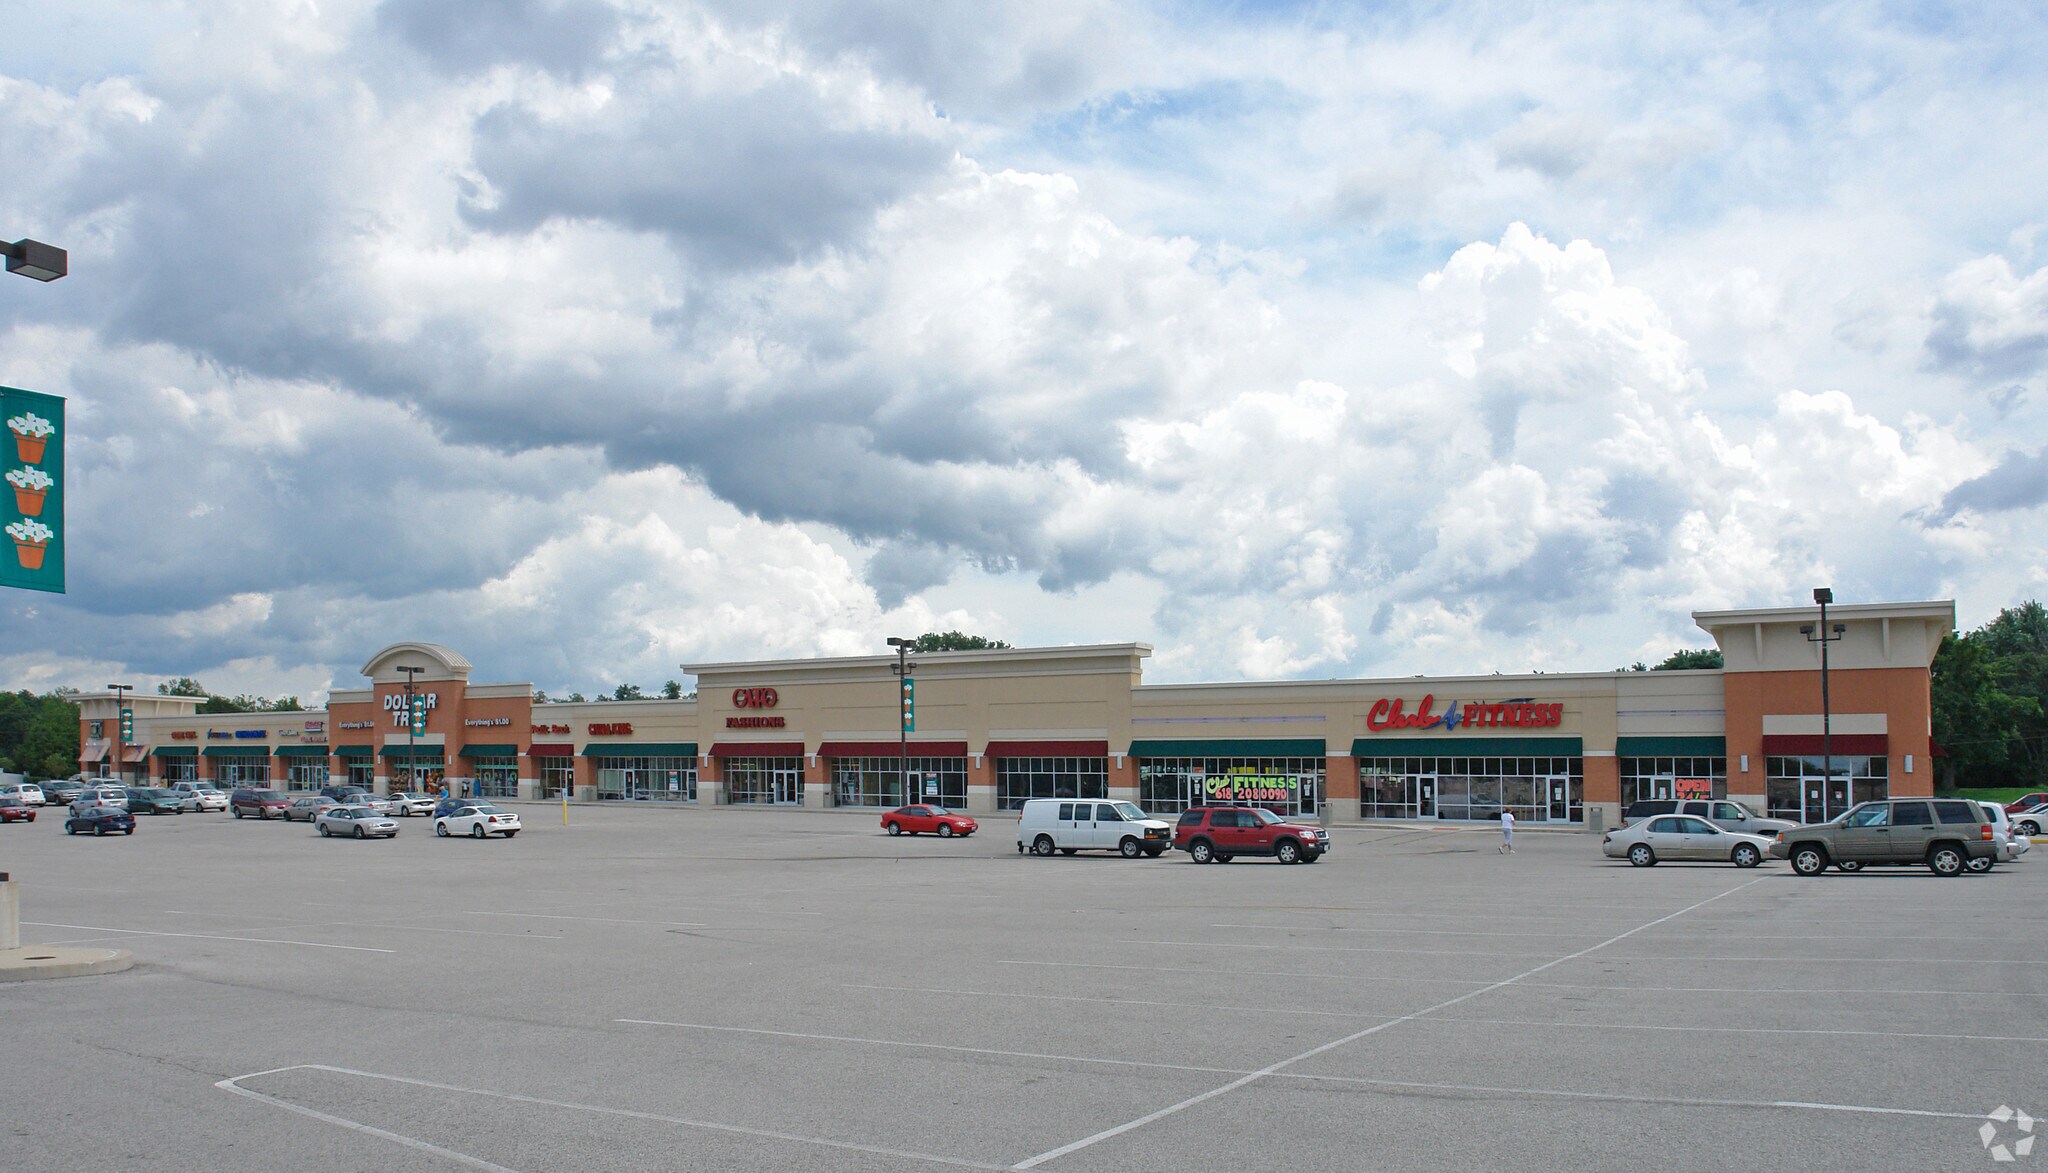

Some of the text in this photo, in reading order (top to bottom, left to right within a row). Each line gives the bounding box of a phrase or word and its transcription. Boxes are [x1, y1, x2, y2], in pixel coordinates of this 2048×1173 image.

[383, 693, 437, 710] DOLR
[732, 687, 778, 708] CATO
[392, 711, 427, 727] TR
[1367, 694, 1563, 732] Club FITNESS
[726, 716, 785, 728] FASHIONS
[1234, 776, 1297, 793] FITNESS
[1675, 778, 1711, 792] OPEN
[1215, 787, 1232, 799] 618
